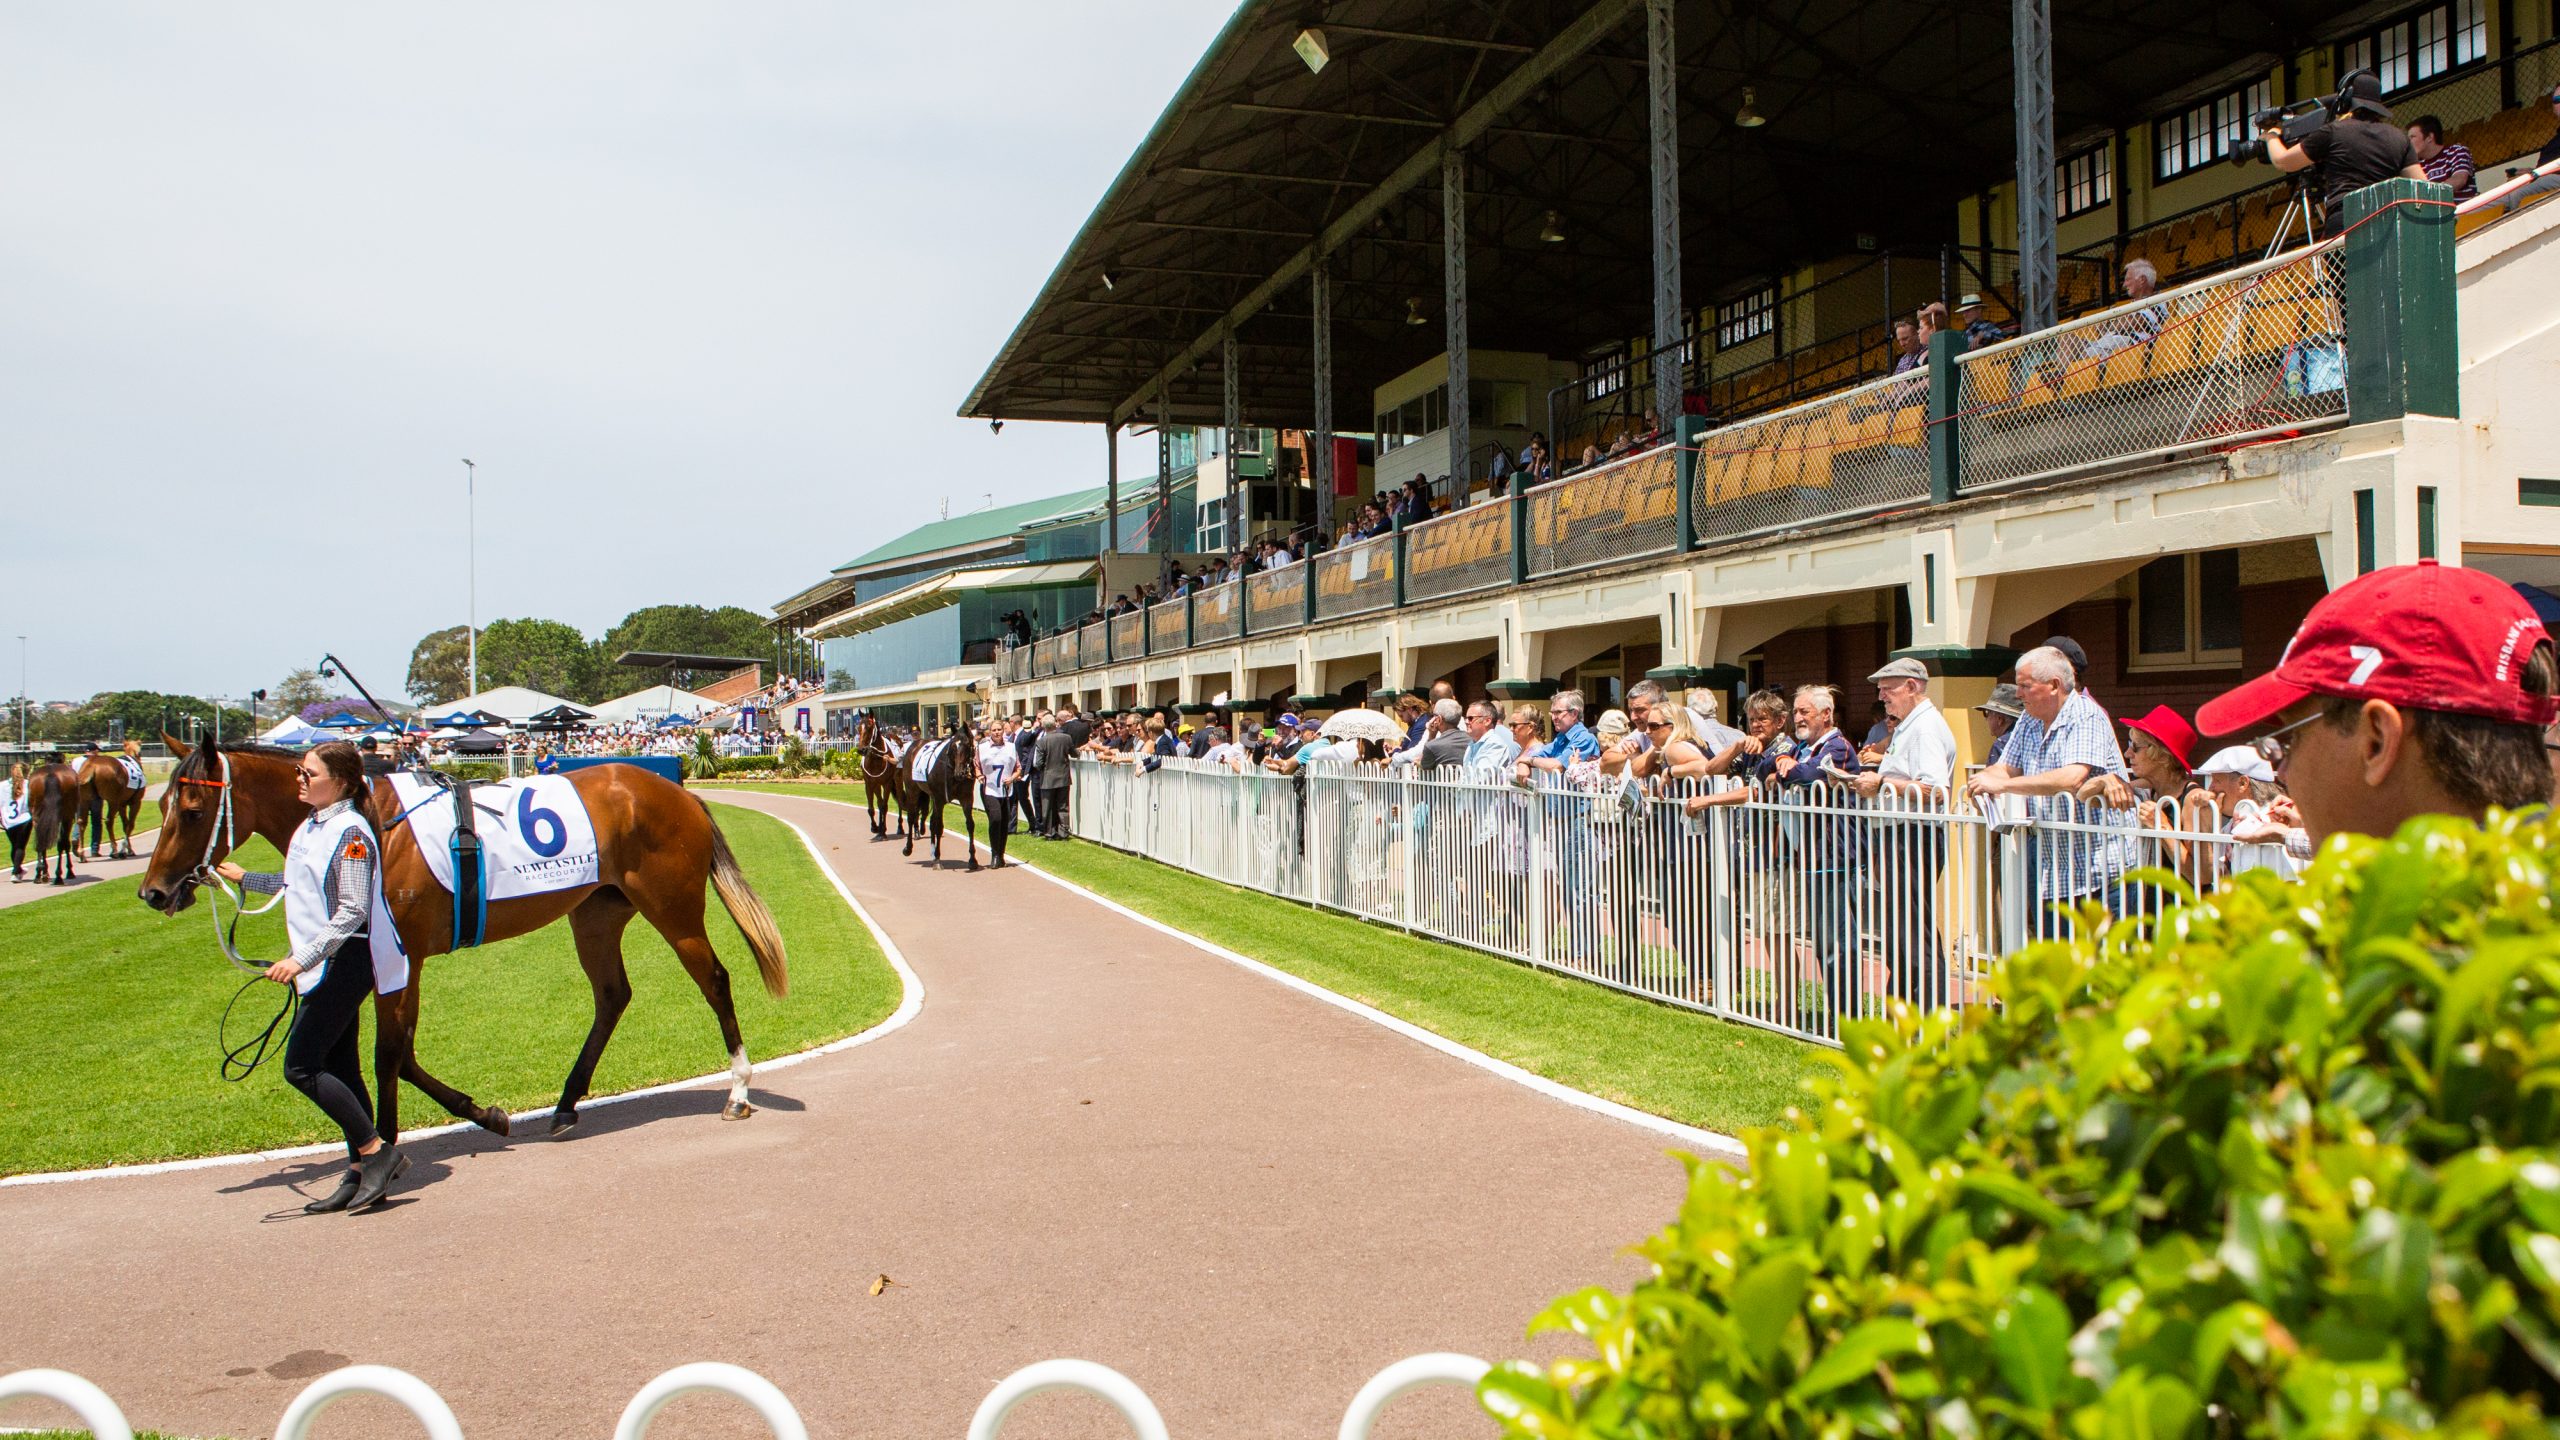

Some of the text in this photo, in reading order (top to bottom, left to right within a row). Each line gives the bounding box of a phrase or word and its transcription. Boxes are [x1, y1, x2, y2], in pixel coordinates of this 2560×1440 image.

[2348, 645, 2383, 686] 7
[992, 764, 1005, 788] 7
[8, 801, 19, 820] 3
[518, 786, 568, 858] 6
[513, 853, 595, 875] NEWCASTLE
[525, 866, 588, 881] RACECOURSE
